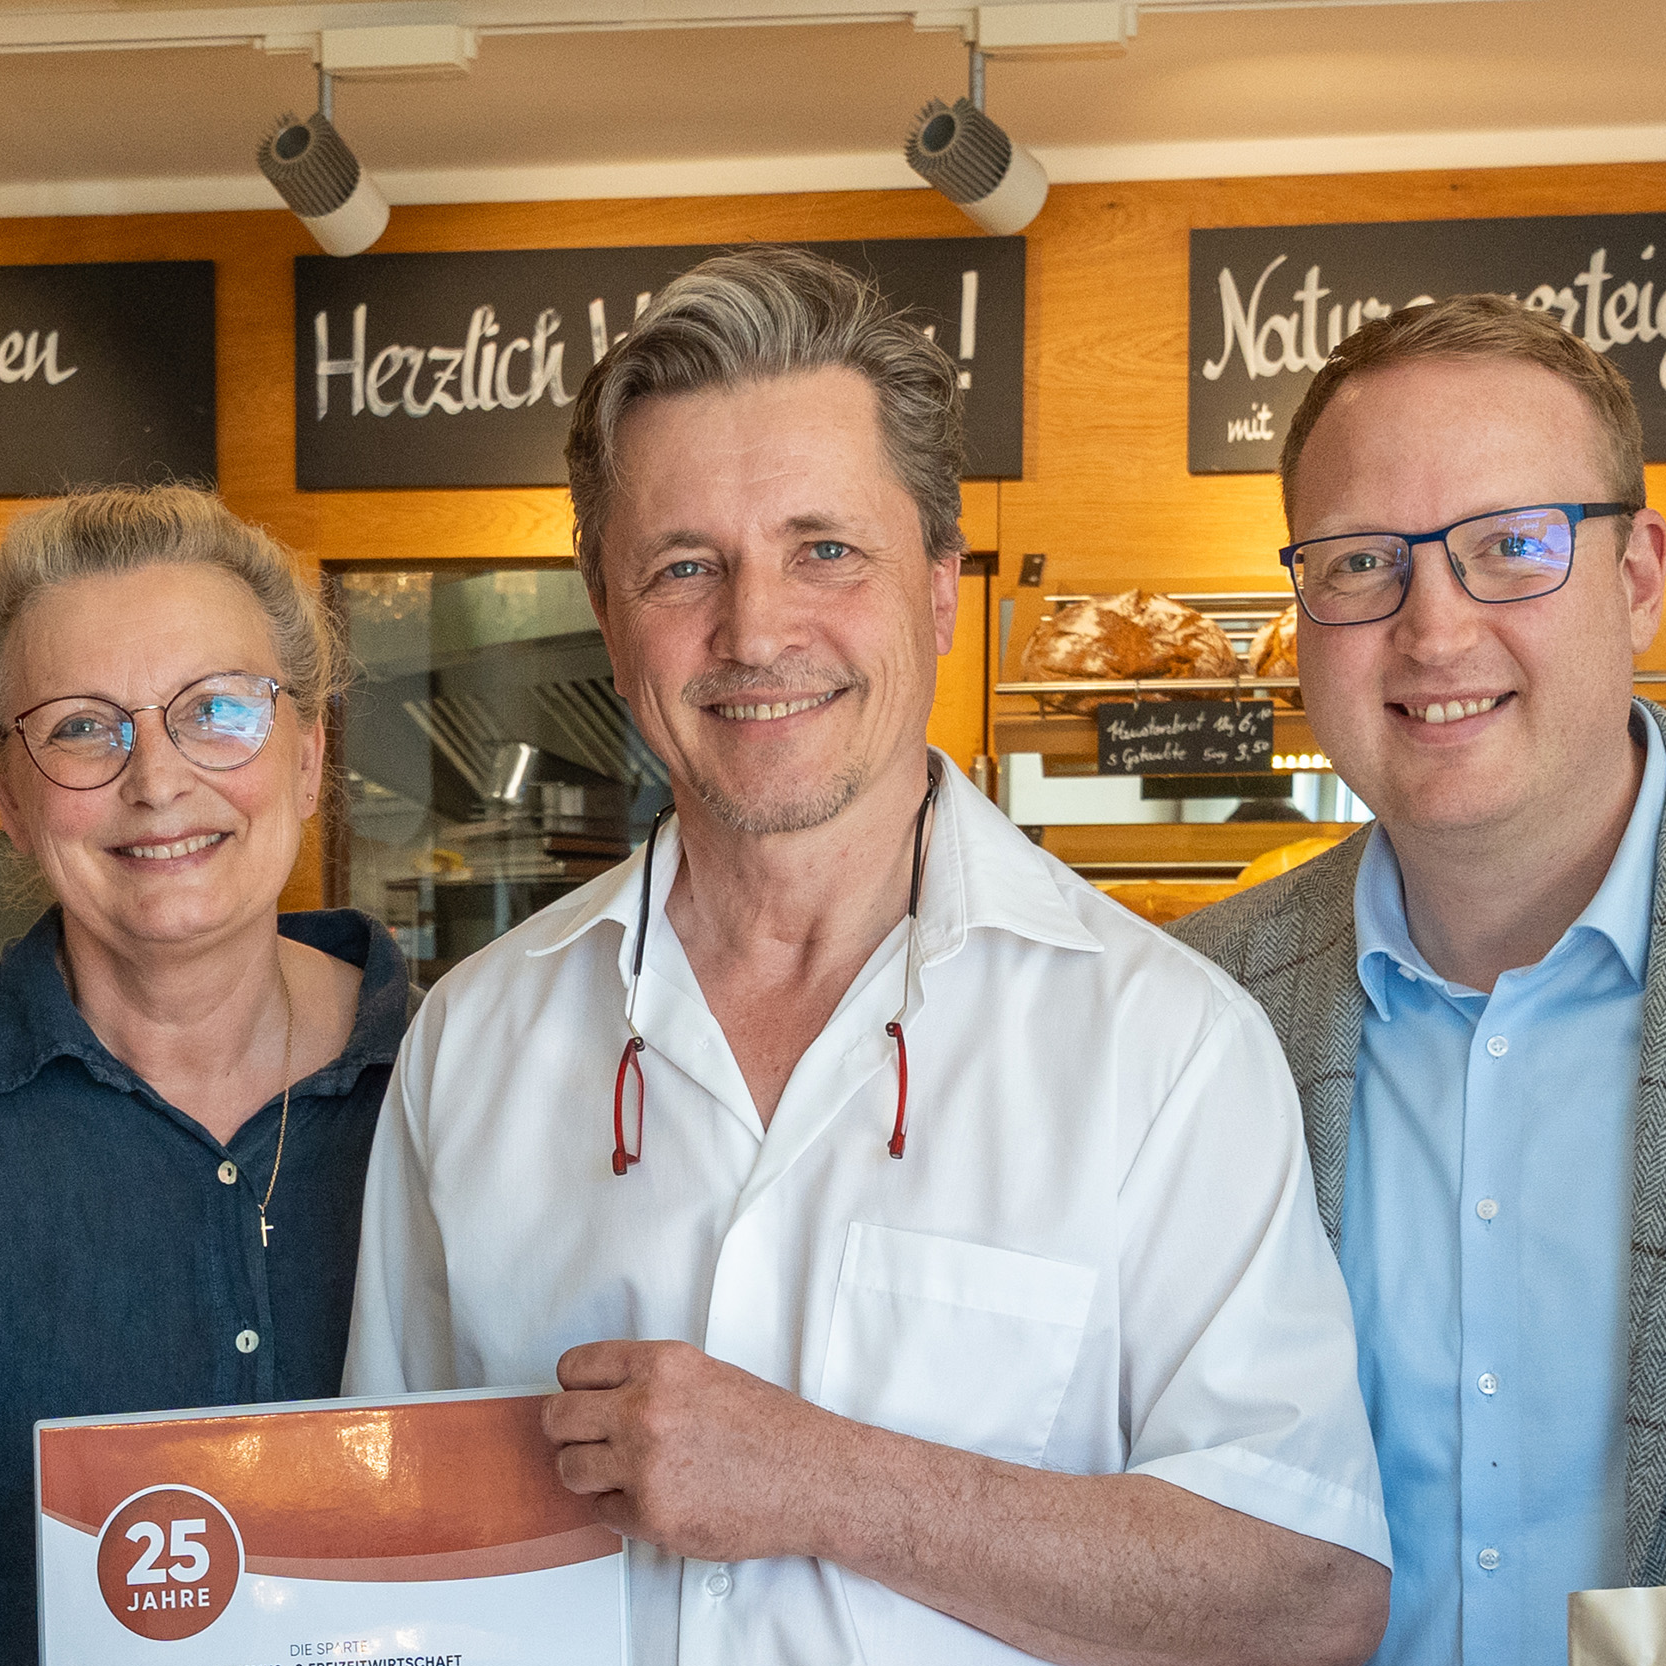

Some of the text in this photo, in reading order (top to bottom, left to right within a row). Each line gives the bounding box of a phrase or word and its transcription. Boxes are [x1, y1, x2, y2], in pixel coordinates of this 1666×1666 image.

[313, 302, 578, 421] Herzlich
[1226, 401, 1276, 443] mit
[125, 1518, 211, 1586] 25
[126, 1587, 211, 1612] JAHRE
[290, 1643, 313, 1657] DIE
